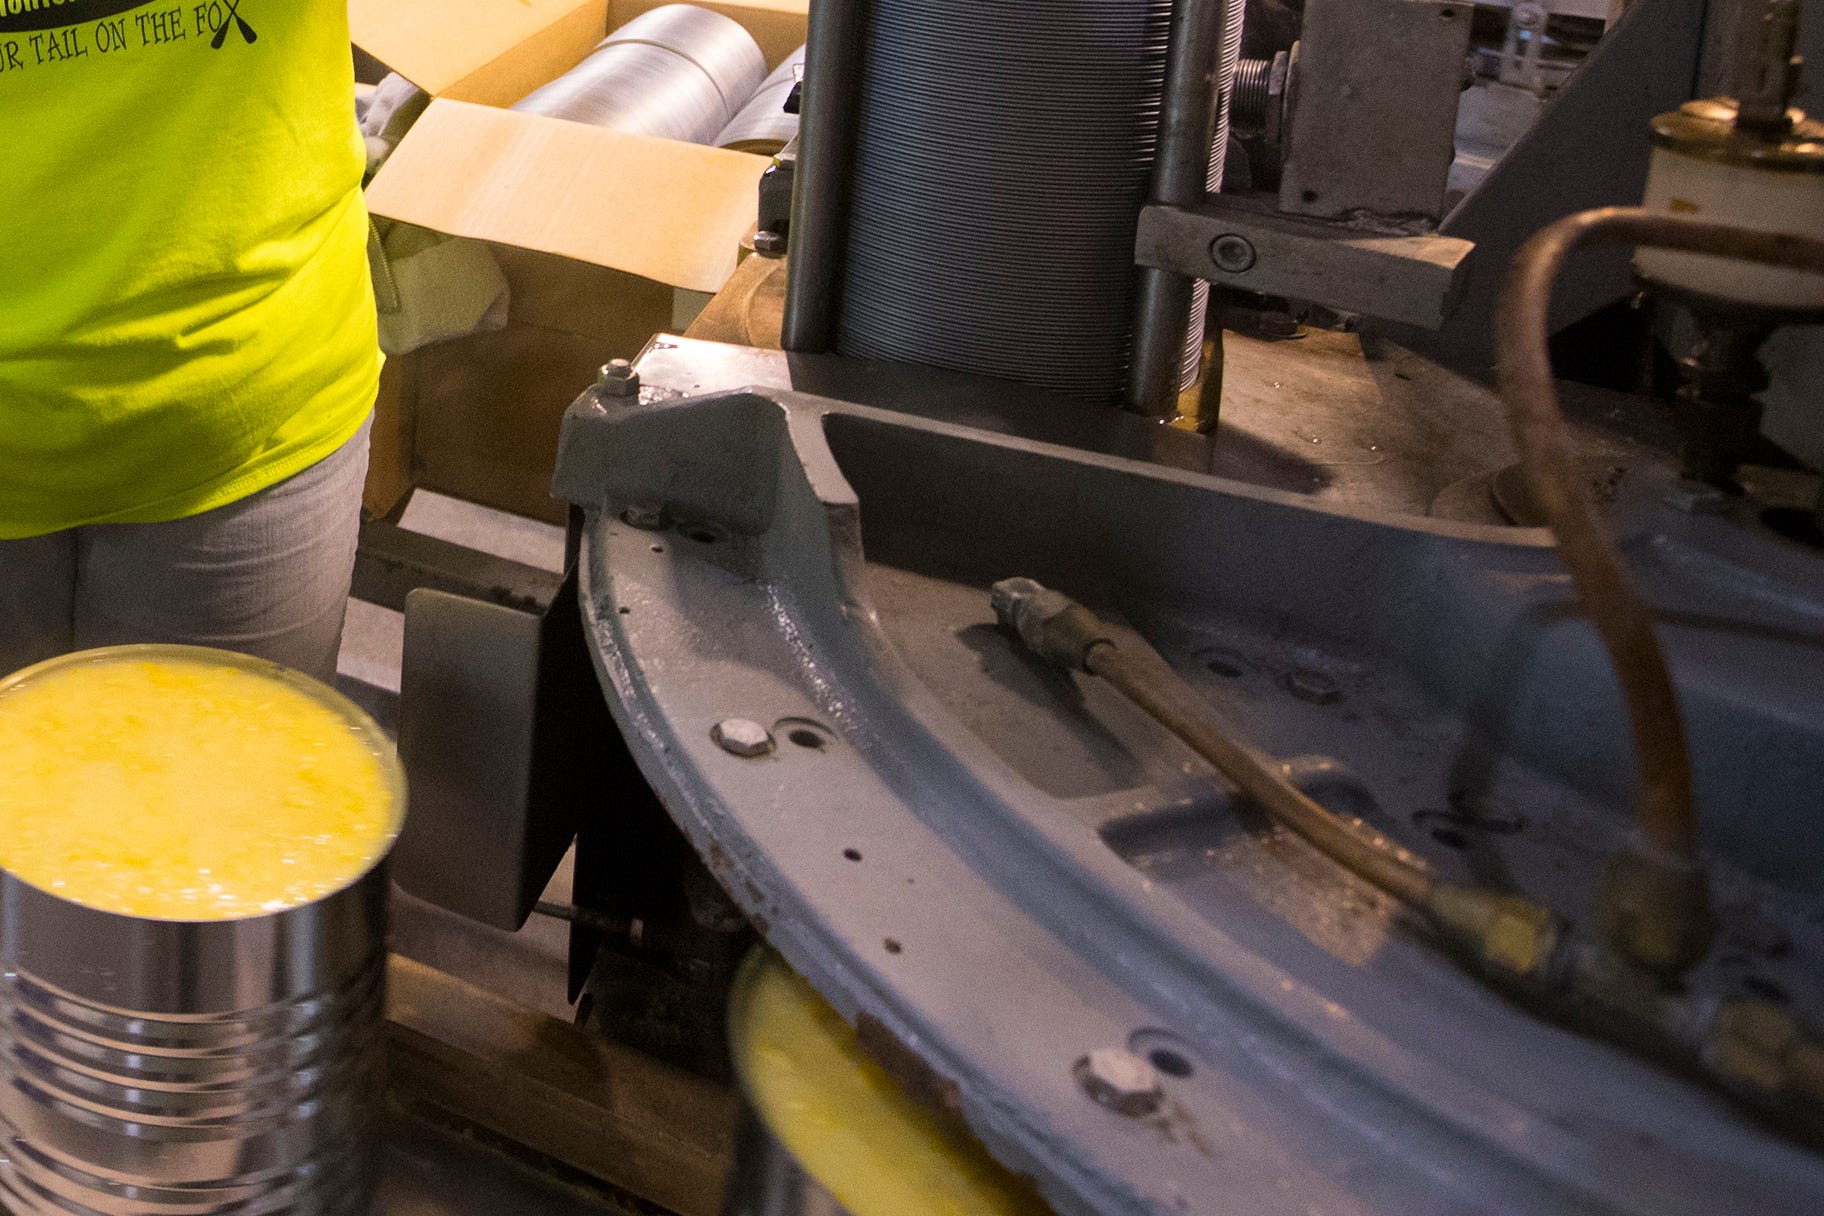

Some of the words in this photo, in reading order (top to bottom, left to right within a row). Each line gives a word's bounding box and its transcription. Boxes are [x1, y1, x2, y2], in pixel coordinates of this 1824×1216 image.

[29, 27, 88, 65] TAIL
[95, 18, 128, 54] ON
[135, 5, 187, 47] THE
